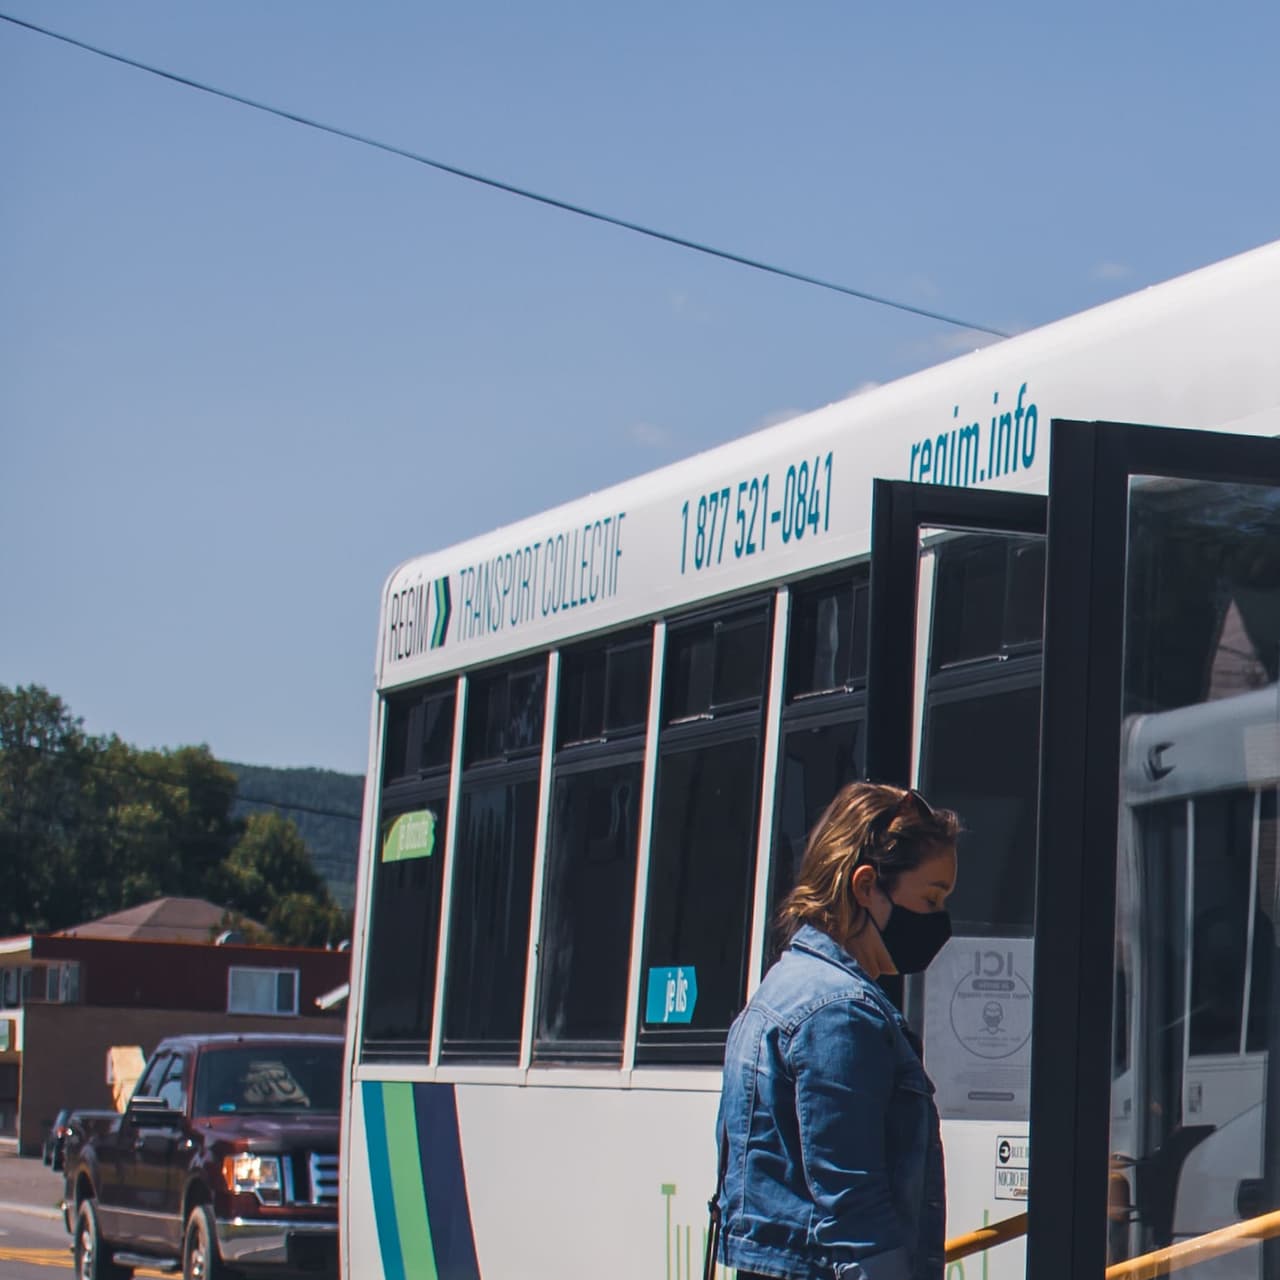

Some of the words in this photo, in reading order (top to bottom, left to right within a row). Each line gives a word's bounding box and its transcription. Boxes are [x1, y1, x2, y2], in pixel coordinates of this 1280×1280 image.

[909, 382, 1038, 487] regim.info
[680, 499, 689, 575] 1
[694, 486, 731, 571] 877
[733, 451, 833, 559] 521-0841
[457, 542, 542, 643] TRANSPORT
[542, 512, 626, 618] COLLECTIF
[664, 971, 676, 1023] je
[675, 967, 688, 1013] lis
